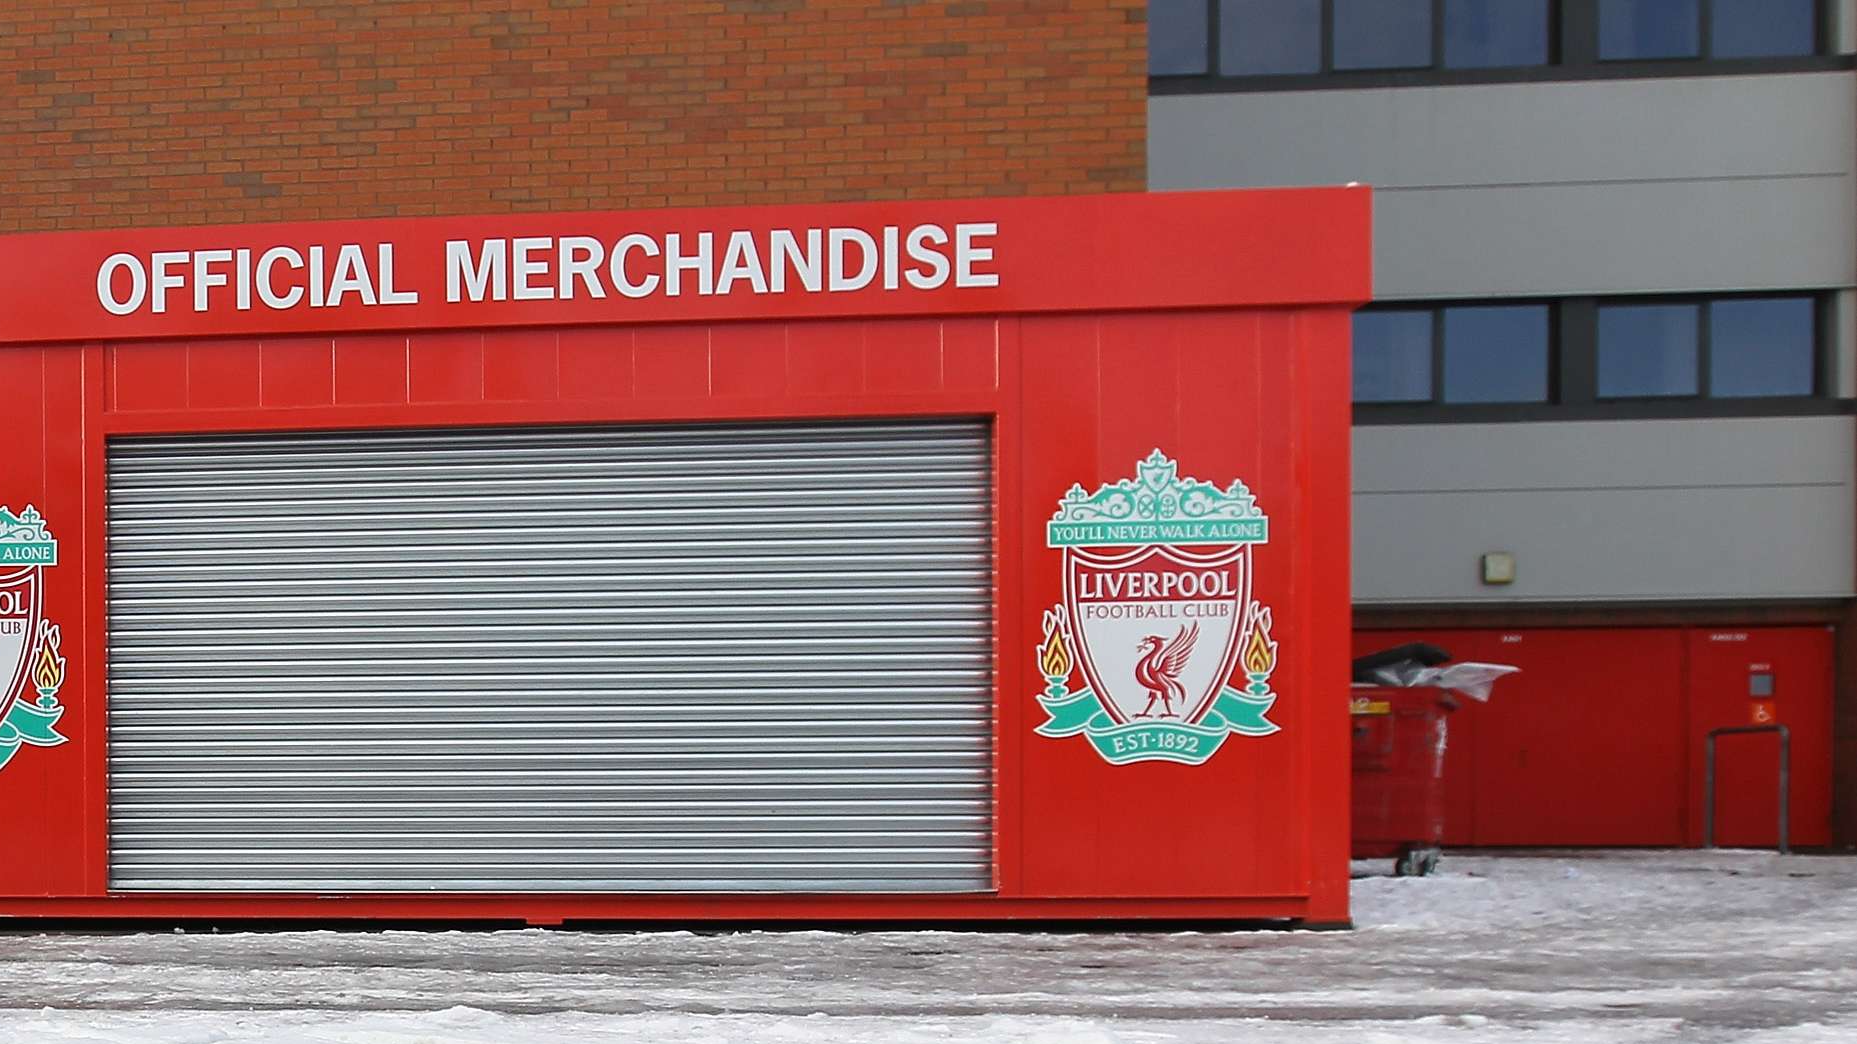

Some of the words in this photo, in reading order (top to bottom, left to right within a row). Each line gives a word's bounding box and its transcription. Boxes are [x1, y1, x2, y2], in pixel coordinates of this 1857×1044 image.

[96, 242, 419, 316] OFFICIAL
[445, 222, 1000, 304] MERCHANDISE
[1054, 526, 1104, 541] YOU'LL
[1107, 525, 1158, 540] NEVER
[1158, 524, 1205, 539] WALK
[1208, 523, 1262, 538] ALONE
[3, 546, 50, 560] ALONE
[1079, 570, 1237, 599] LIVERPOOL
[1086, 604, 1177, 619] FOOTBALL
[1183, 603, 1229, 618] CLUB
